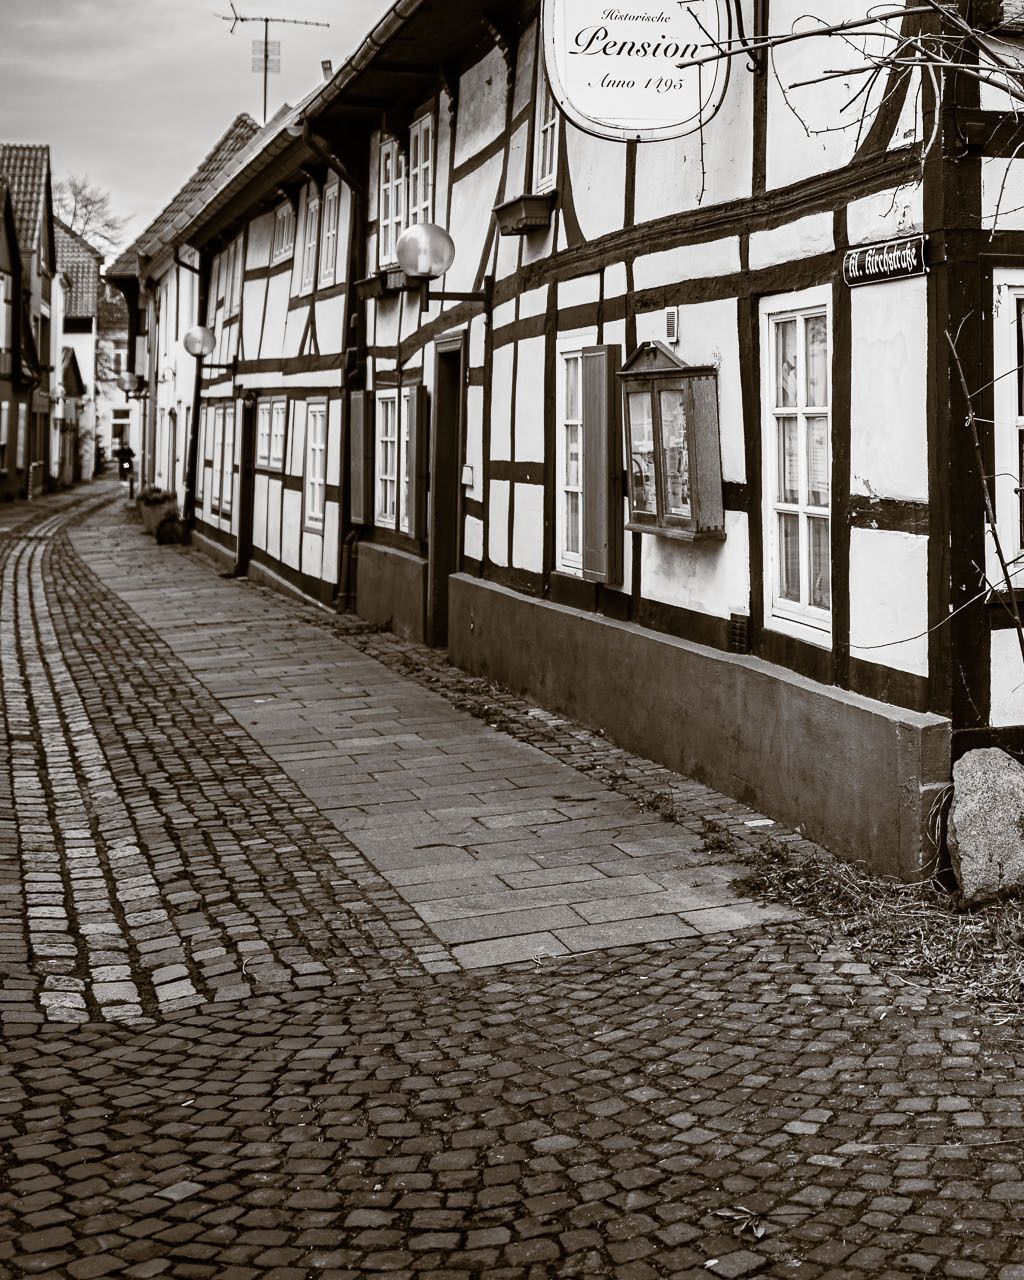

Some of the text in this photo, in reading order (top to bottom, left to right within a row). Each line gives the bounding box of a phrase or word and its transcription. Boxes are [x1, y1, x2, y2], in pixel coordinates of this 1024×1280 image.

[601, 8, 671, 23] Historische
[568, 25, 702, 59] Pension
[587, 72, 684, 94] Anno 1495
[865, 241, 917, 275] Kirchstraße
